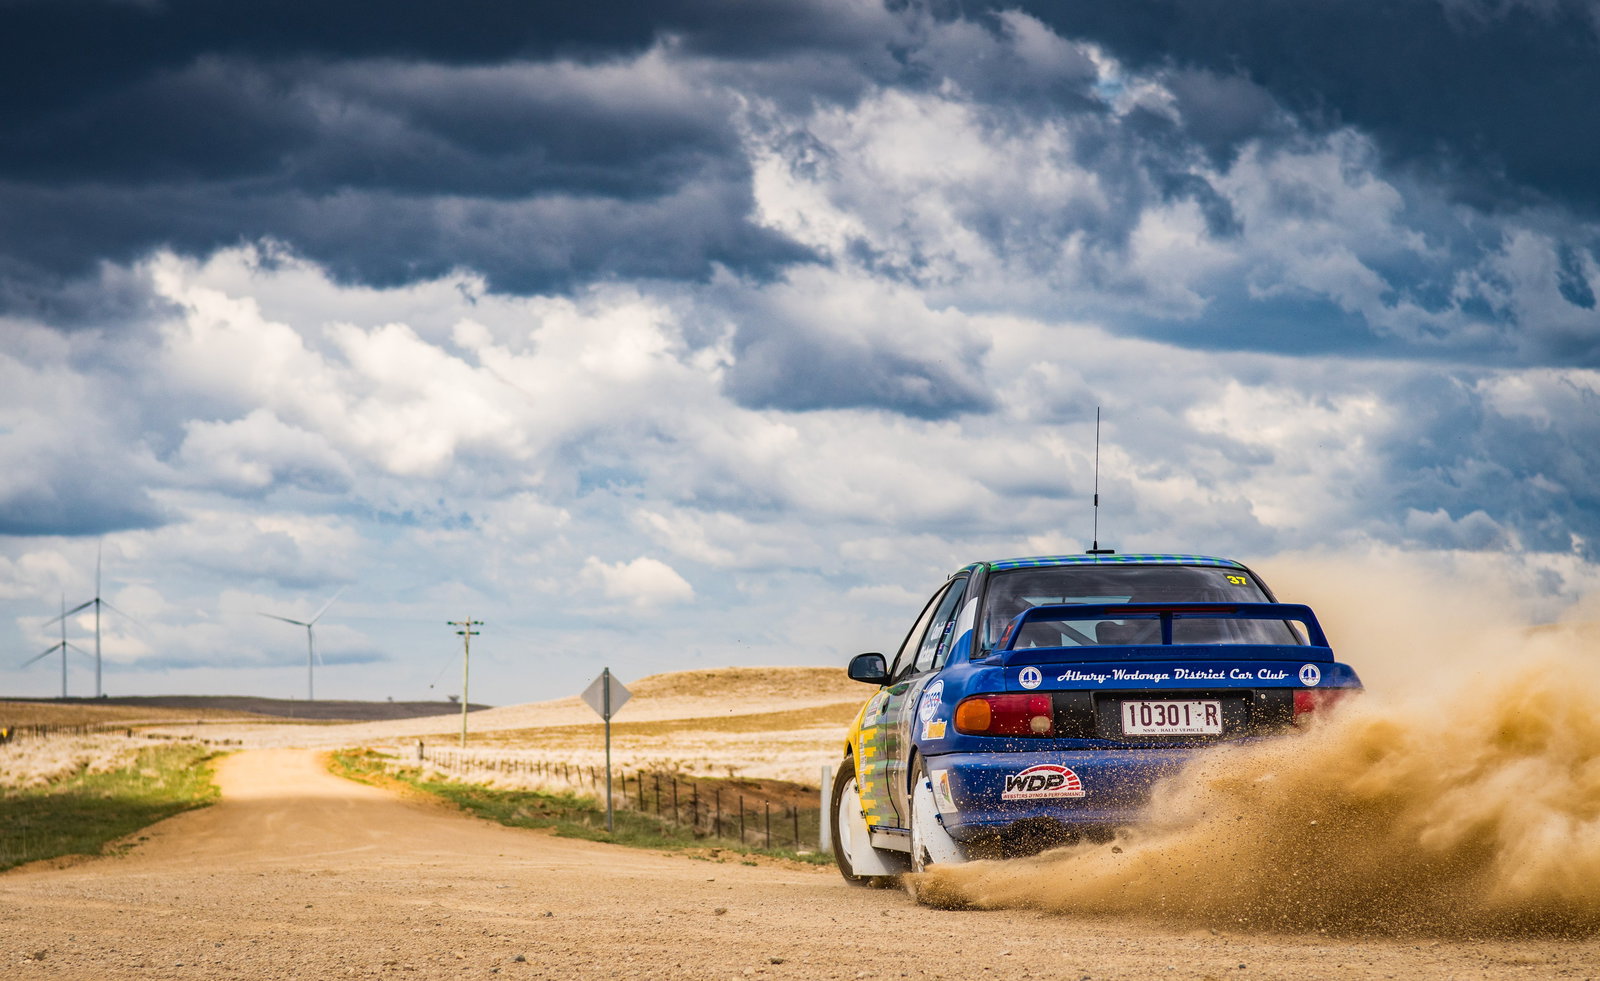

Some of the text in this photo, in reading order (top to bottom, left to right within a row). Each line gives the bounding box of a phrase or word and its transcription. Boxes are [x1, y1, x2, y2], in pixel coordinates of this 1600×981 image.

[1227, 576, 1247, 585] 37
[1057, 669, 1170, 684] Albury-Wodonga
[1174, 668, 1226, 680] District
[1229, 668, 1254, 680] Car
[1257, 668, 1289, 680] Club
[1006, 775, 1065, 792] WDP
